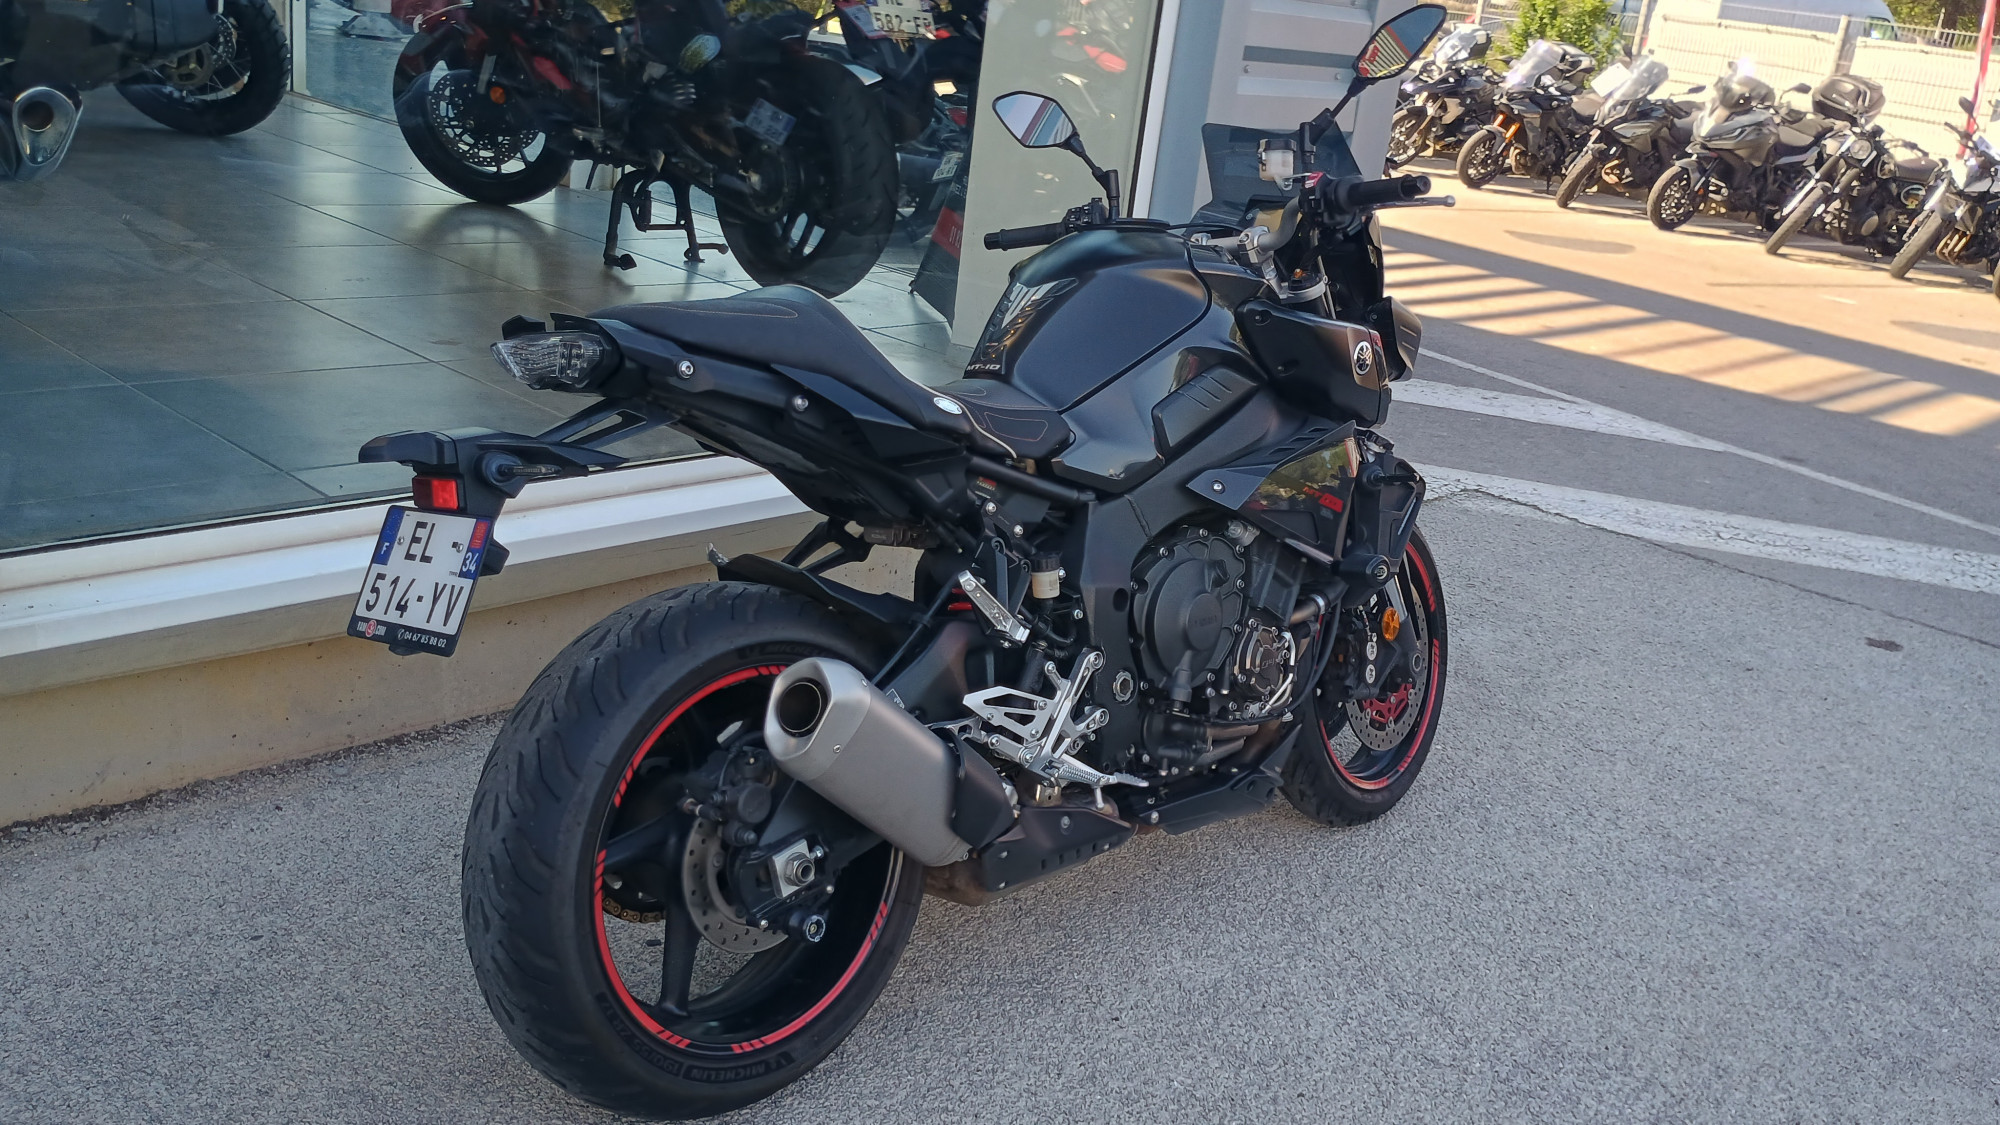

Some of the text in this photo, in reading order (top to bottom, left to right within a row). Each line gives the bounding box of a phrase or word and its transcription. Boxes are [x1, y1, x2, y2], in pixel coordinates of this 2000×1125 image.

[381, 542, 390, 555] F
[404, 521, 436, 564] EL
[462, 552, 478, 573] 34
[365, 573, 465, 627] 514-YV
[404, 631, 413, 640] 04
[412, 633, 420, 642] 67
[438, 638, 447, 648] 02
[690, 1064, 766, 1081] MICHELIN
